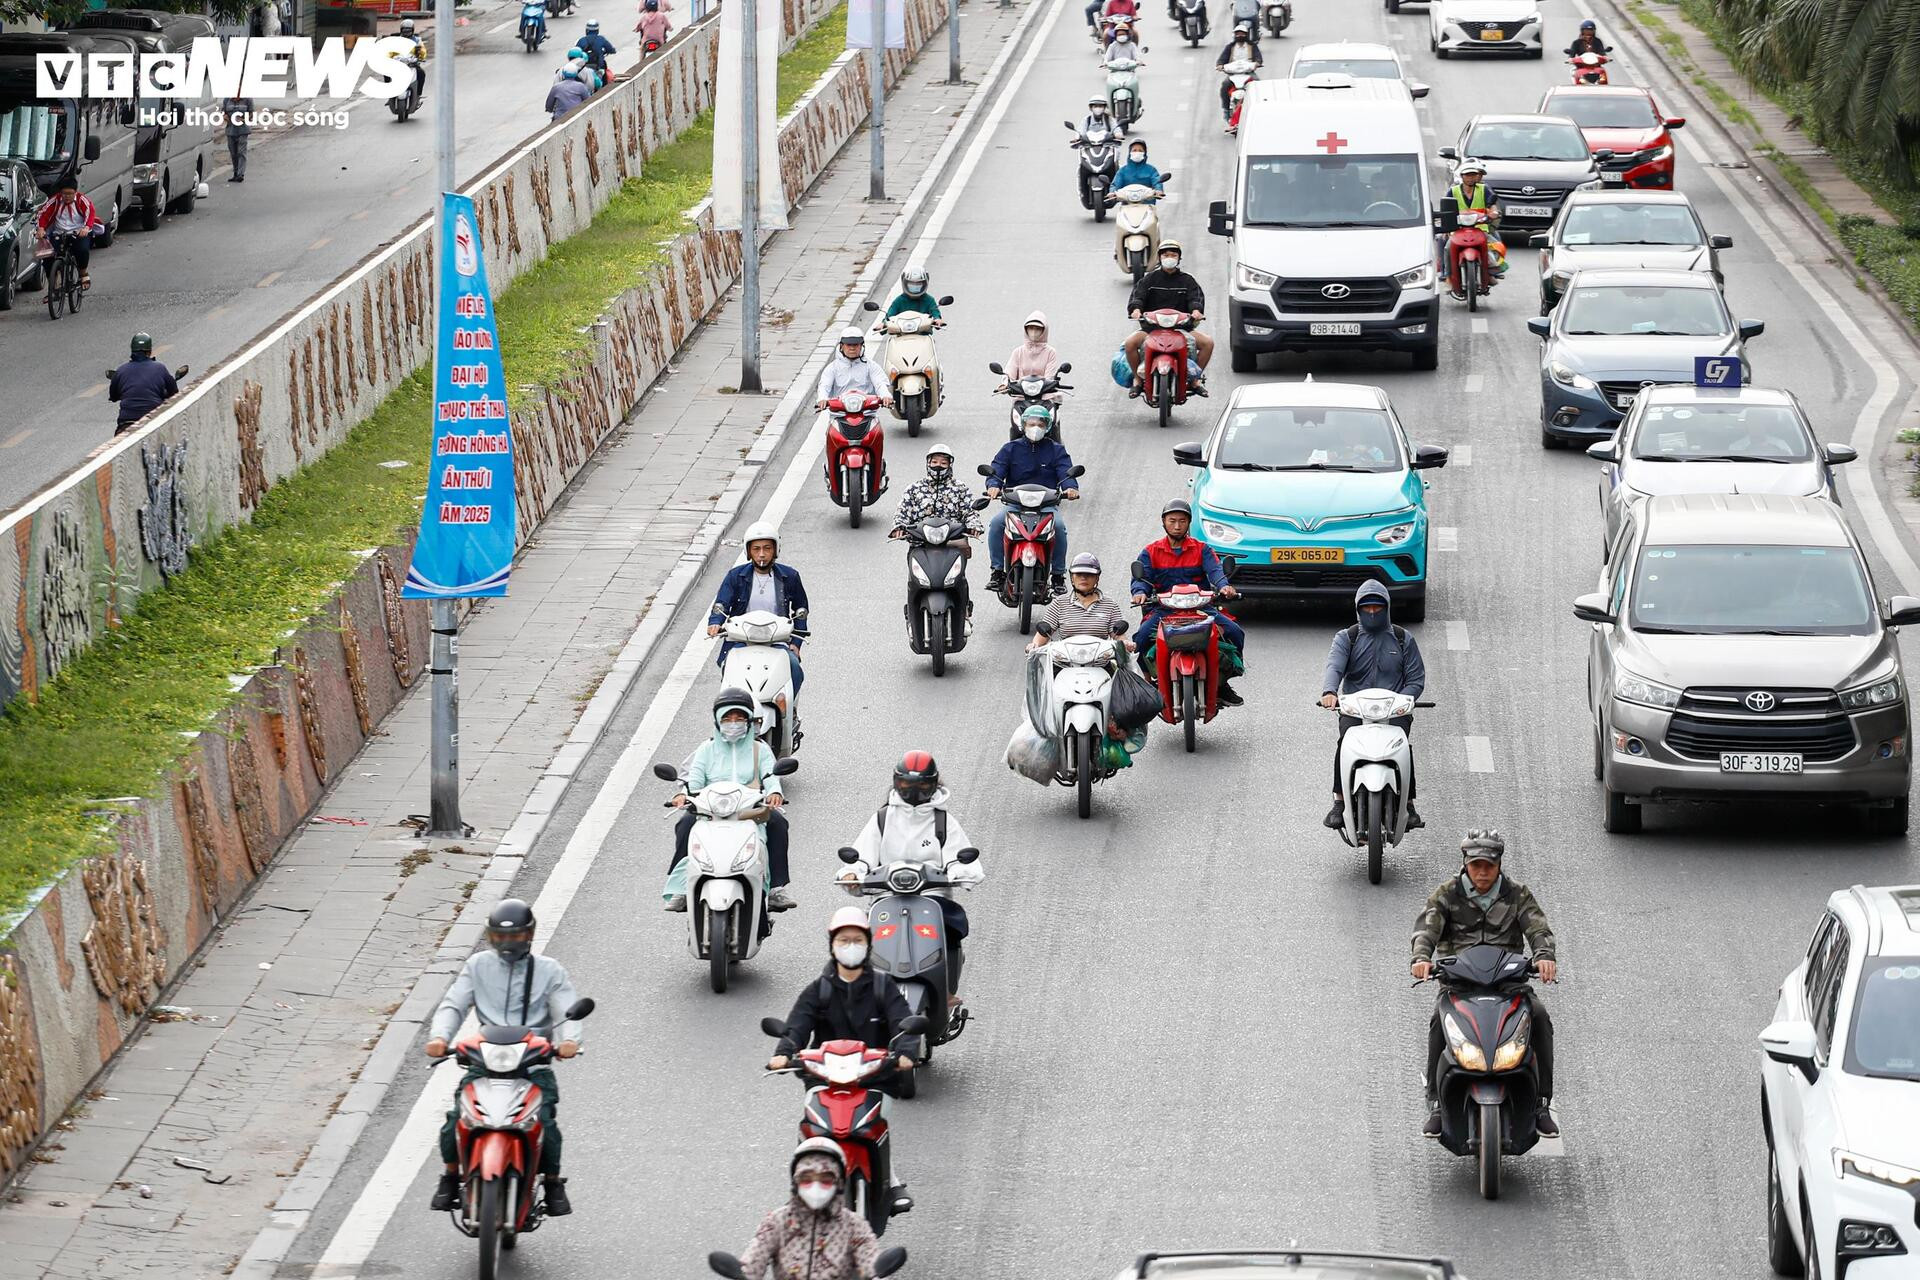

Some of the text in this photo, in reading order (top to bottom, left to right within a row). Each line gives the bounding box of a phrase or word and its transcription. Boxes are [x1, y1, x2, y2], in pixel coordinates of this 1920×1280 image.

[452, 366, 471, 387] ĐẠI
[1706, 360, 1730, 383] G7
[470, 431, 496, 453] HỒNG
[464, 468, 485, 487] THỨ
[464, 506, 490, 522] 2025
[1277, 550, 1338, 561] 29K-065.02
[1723, 755, 1800, 771] 30F-319.29
